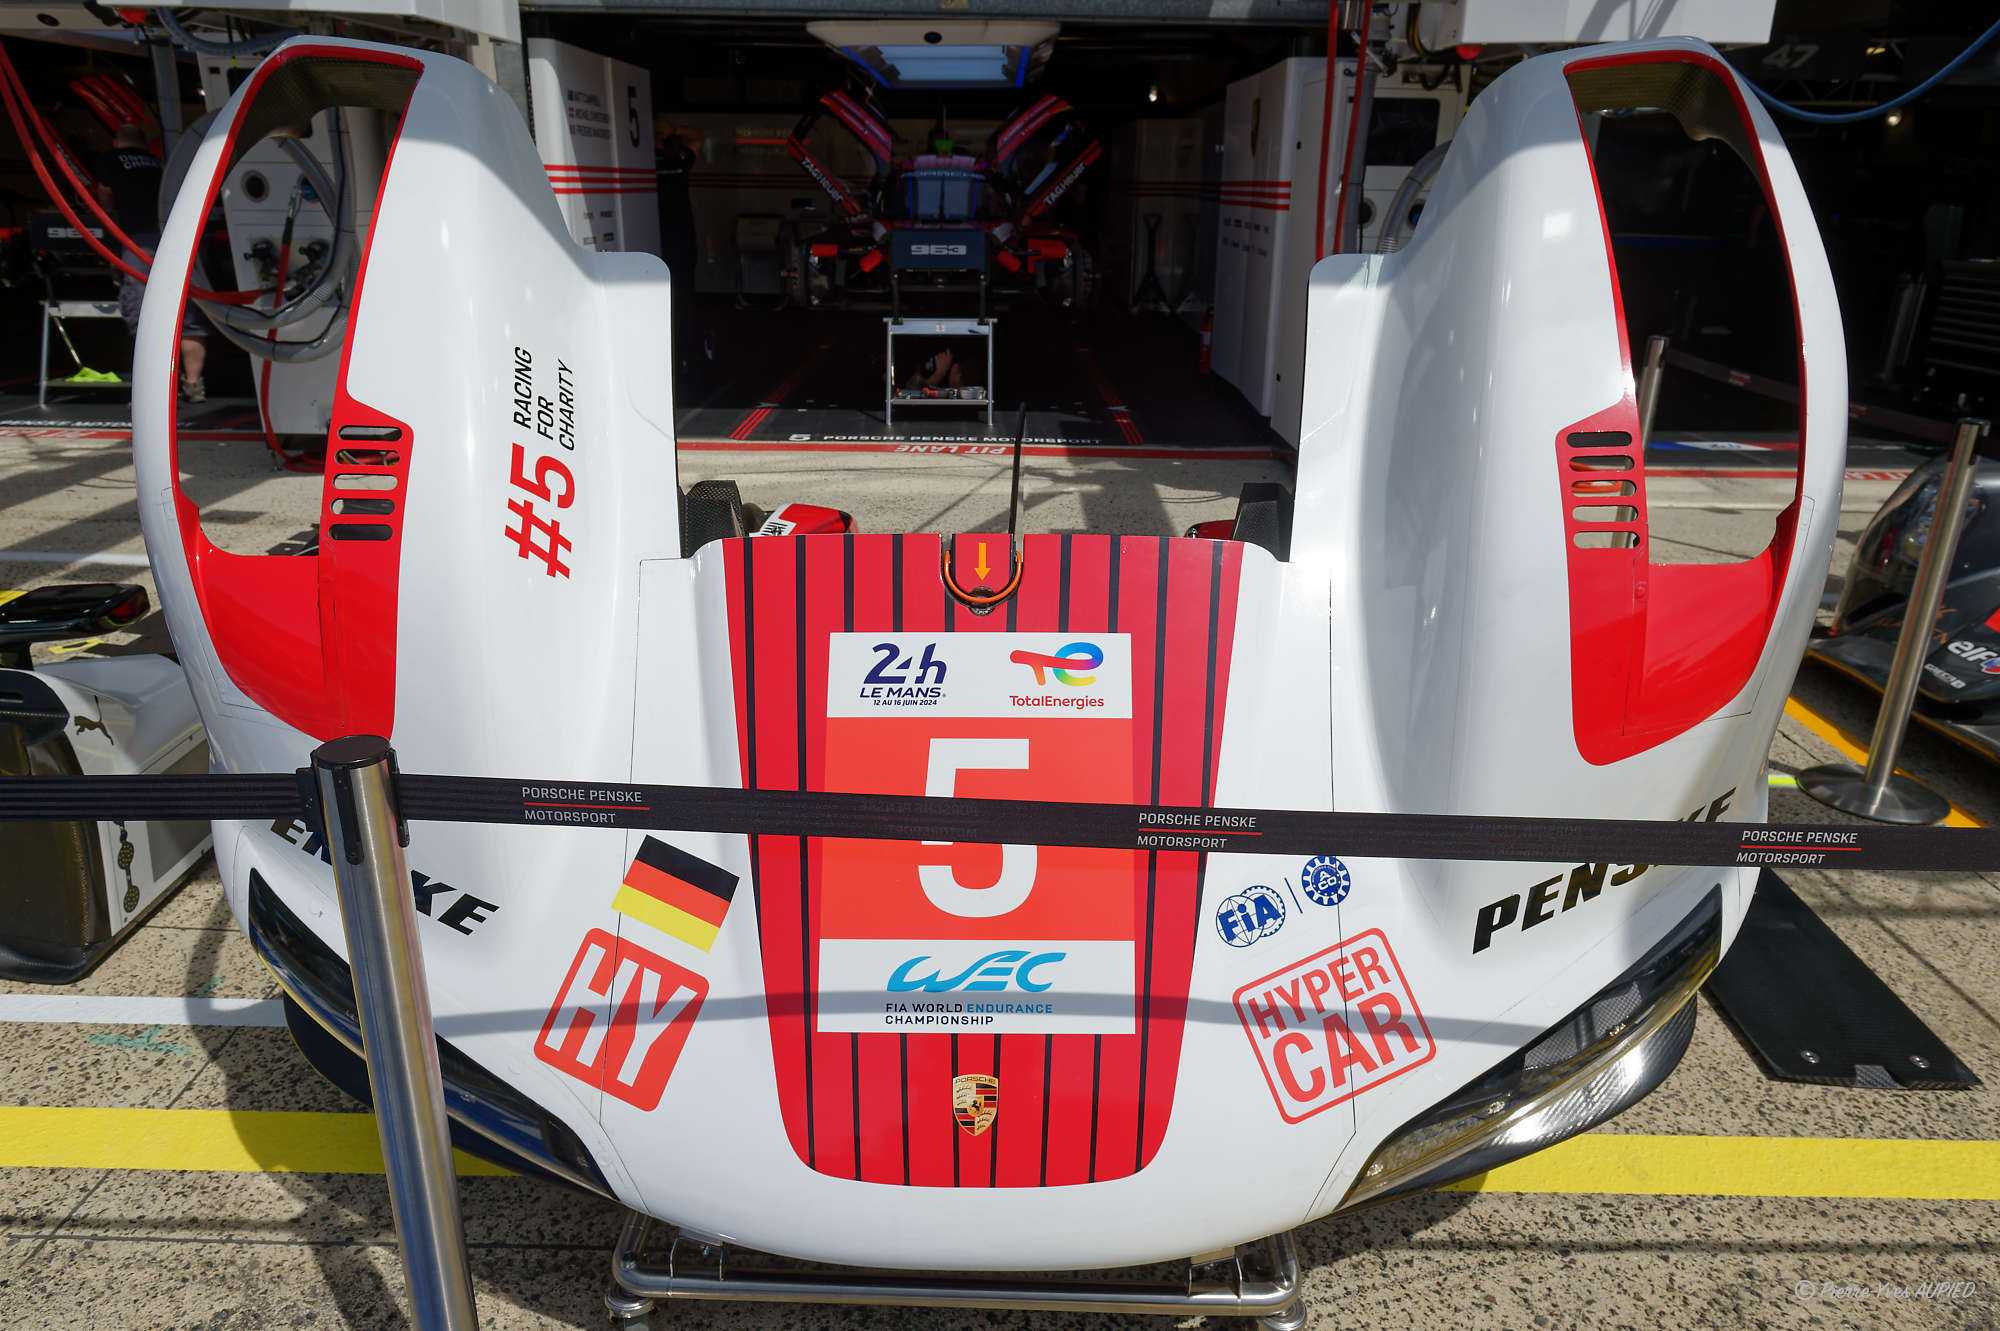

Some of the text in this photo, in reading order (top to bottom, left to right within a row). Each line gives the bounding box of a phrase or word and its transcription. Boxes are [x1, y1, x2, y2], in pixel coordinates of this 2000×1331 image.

[627, 85, 641, 148] 5
[910, 243, 968, 256] 963
[513, 346, 532, 429] RACING
[557, 358, 575, 451] CHARITY
[537, 395, 554, 440] FOR
[789, 433, 811, 441] 5
[504, 441, 576, 579] #5
[1947, 640, 1999, 662] elf
[863, 642, 947, 684] 24h
[859, 687, 941, 698] LE MANS
[902, 699, 918, 707] JUIN
[1009, 695, 1104, 710] TotalEnergies
[522, 786, 643, 803] PORSCHE PENSKE
[524, 809, 616, 824] MOTORSPORT
[1138, 812, 1257, 828] PORSCHE PENSKE
[918, 738, 1038, 918] 5
[1137, 836, 1228, 849] MOTORSPORT
[1741, 830, 1858, 844] PORSCHE PENSKE
[1736, 851, 1826, 865] MOTORSPORT
[886, 950, 1067, 992] WEC
[1247, 946, 1391, 1040] HYPER
[544, 942, 698, 1088] HY
[886, 1003, 1054, 1013] FIA WORLD ENDURANCE
[885, 1015, 994, 1025] CHAMPIONSHIP
[1273, 992, 1422, 1103] CAR
[955, 1076, 996, 1084] PORSCHE
